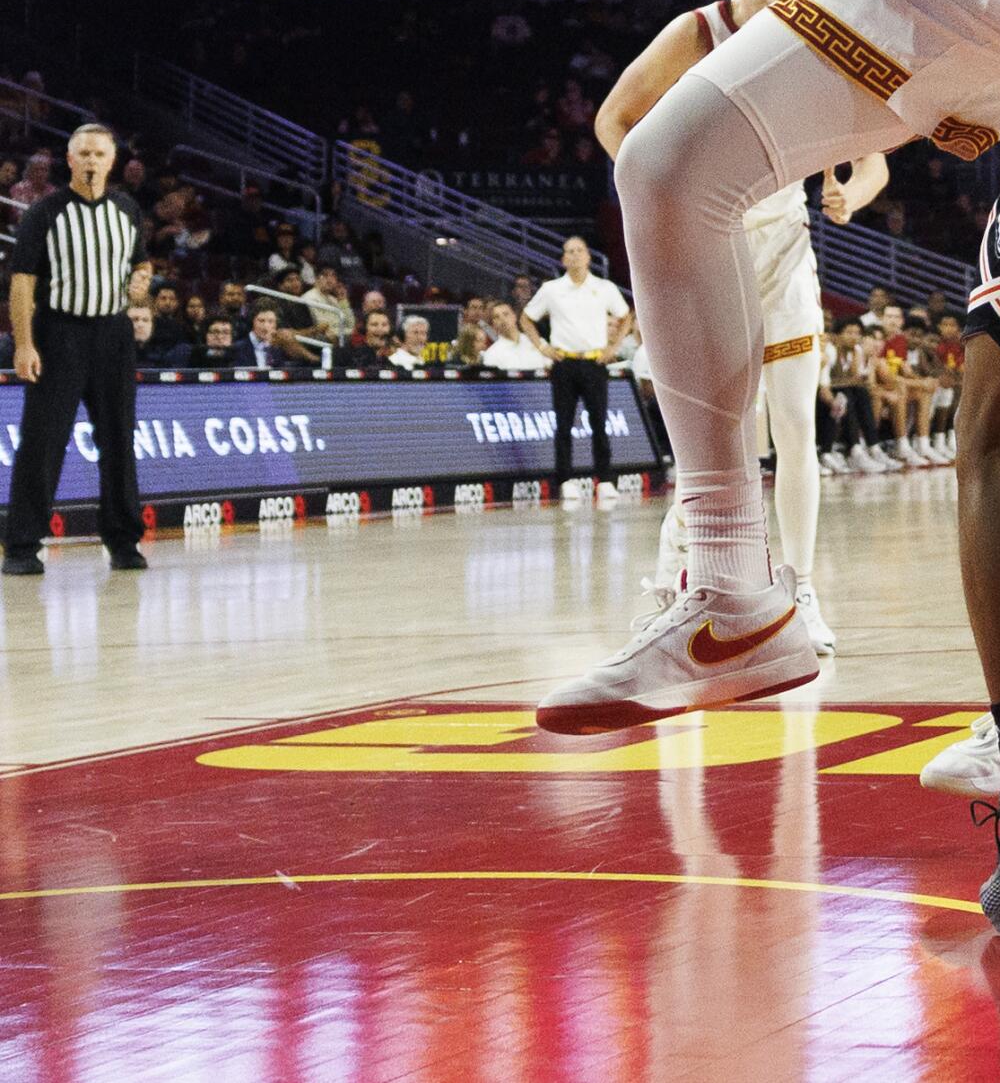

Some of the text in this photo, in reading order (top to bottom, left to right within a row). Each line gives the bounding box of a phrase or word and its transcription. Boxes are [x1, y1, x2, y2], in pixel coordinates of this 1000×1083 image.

[204, 414, 326, 456] COAST.
[455, 483, 484, 504] ARCO
[513, 480, 541, 501] ARCO
[617, 473, 643, 493] ARCO
[259, 496, 295, 520] ARCO
[326, 491, 360, 516] ARCO
[392, 486, 423, 509] ARCO
[183, 501, 222, 526] ARCO
